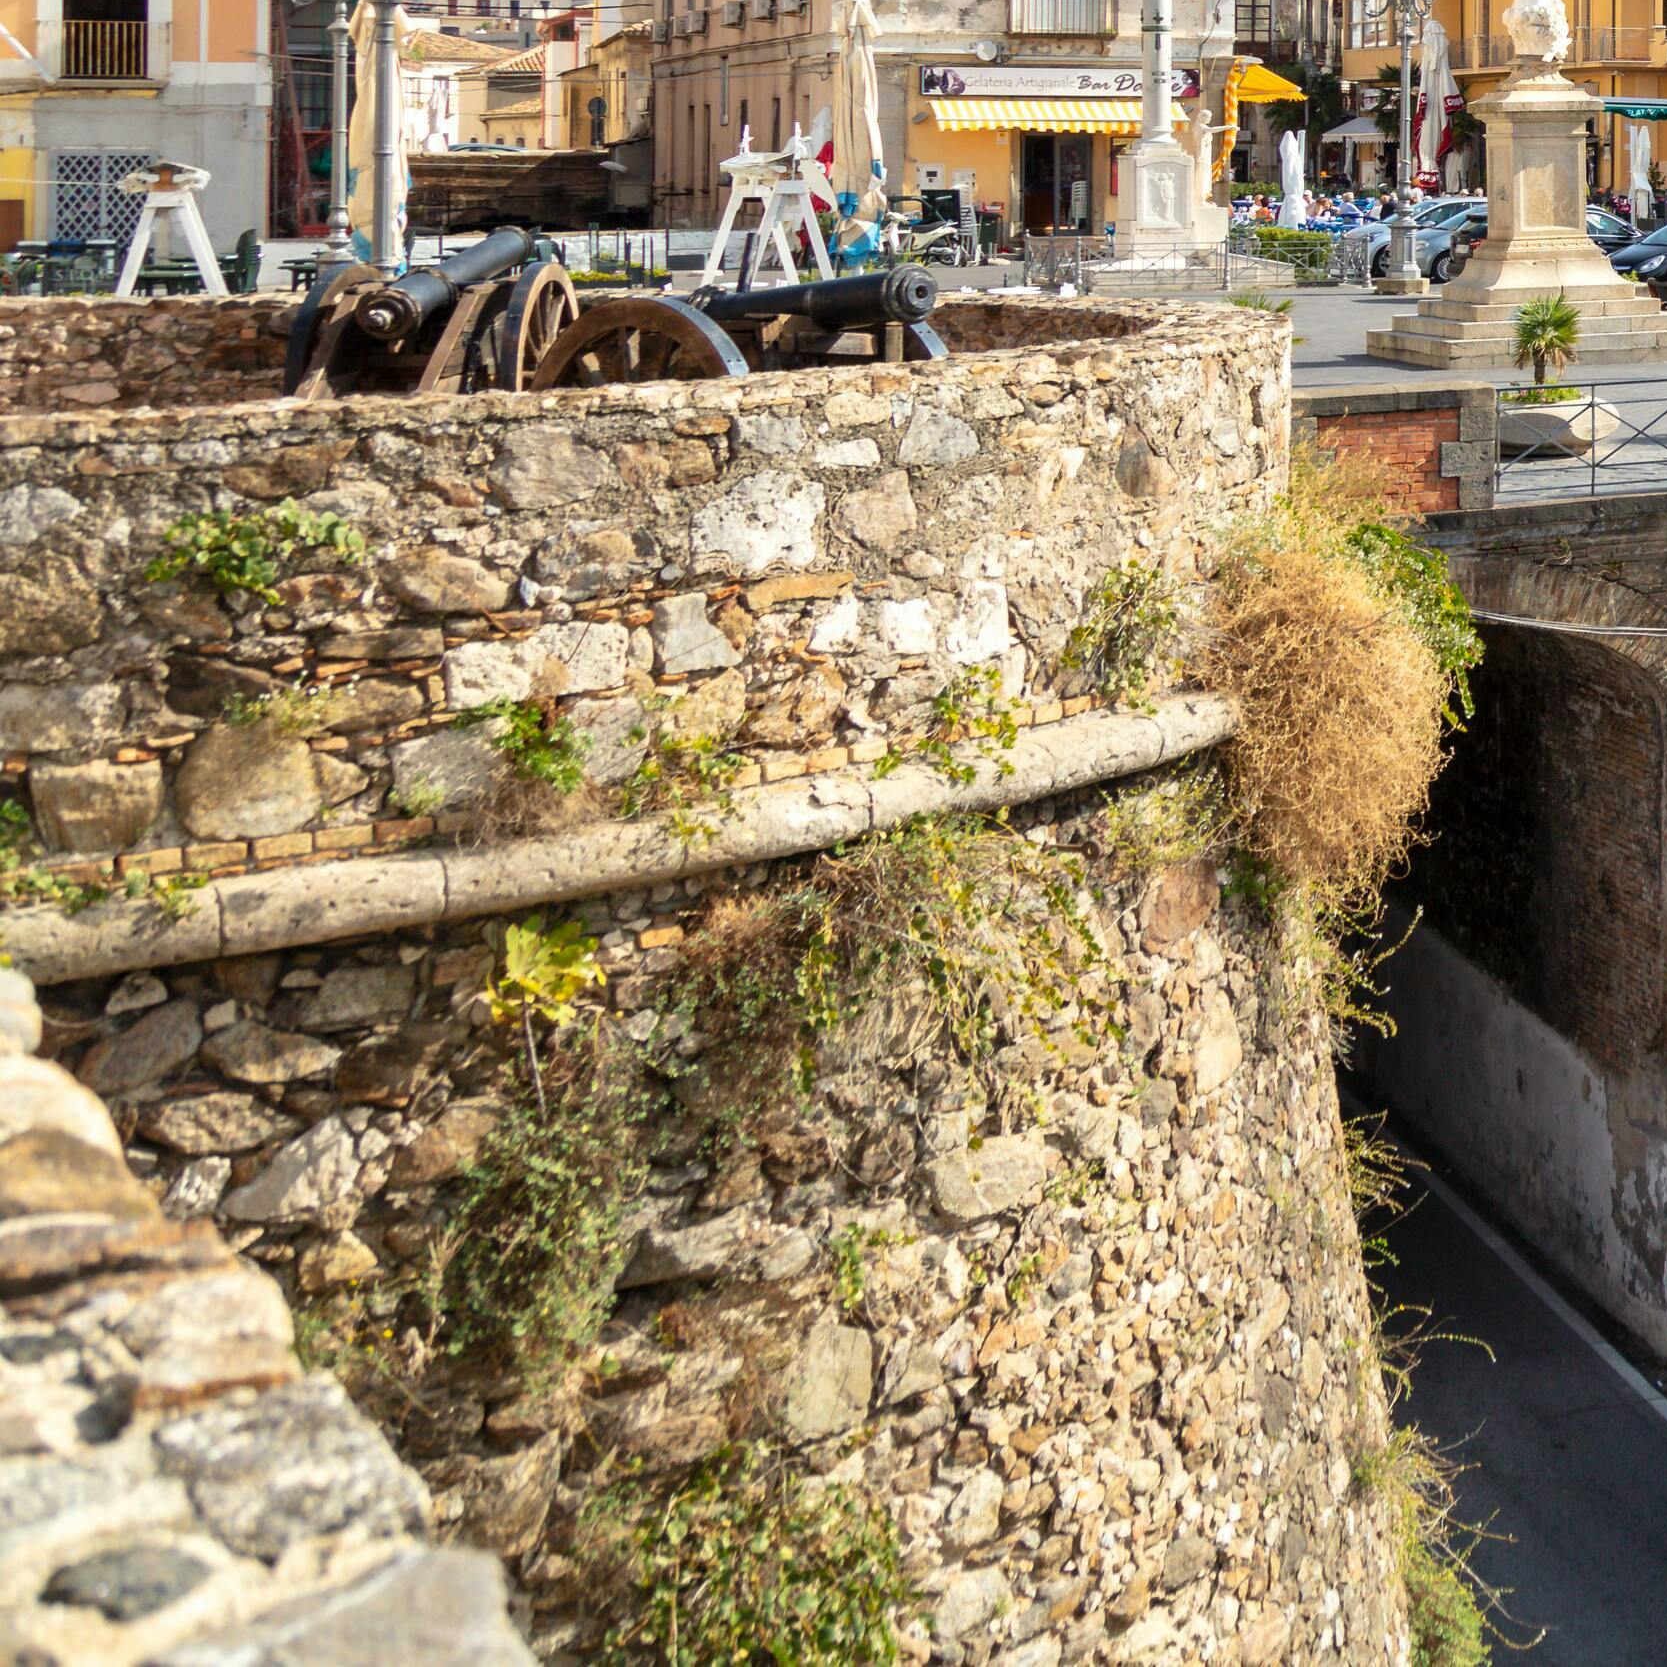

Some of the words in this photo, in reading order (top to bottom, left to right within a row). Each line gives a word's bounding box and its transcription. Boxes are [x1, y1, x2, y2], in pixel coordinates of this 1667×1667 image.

[965, 74, 1012, 88] Gelateria
[1015, 75, 1075, 91] Artigianale
[1077, 74, 1111, 91] Bar
[1114, 73, 1182, 93] Dae
